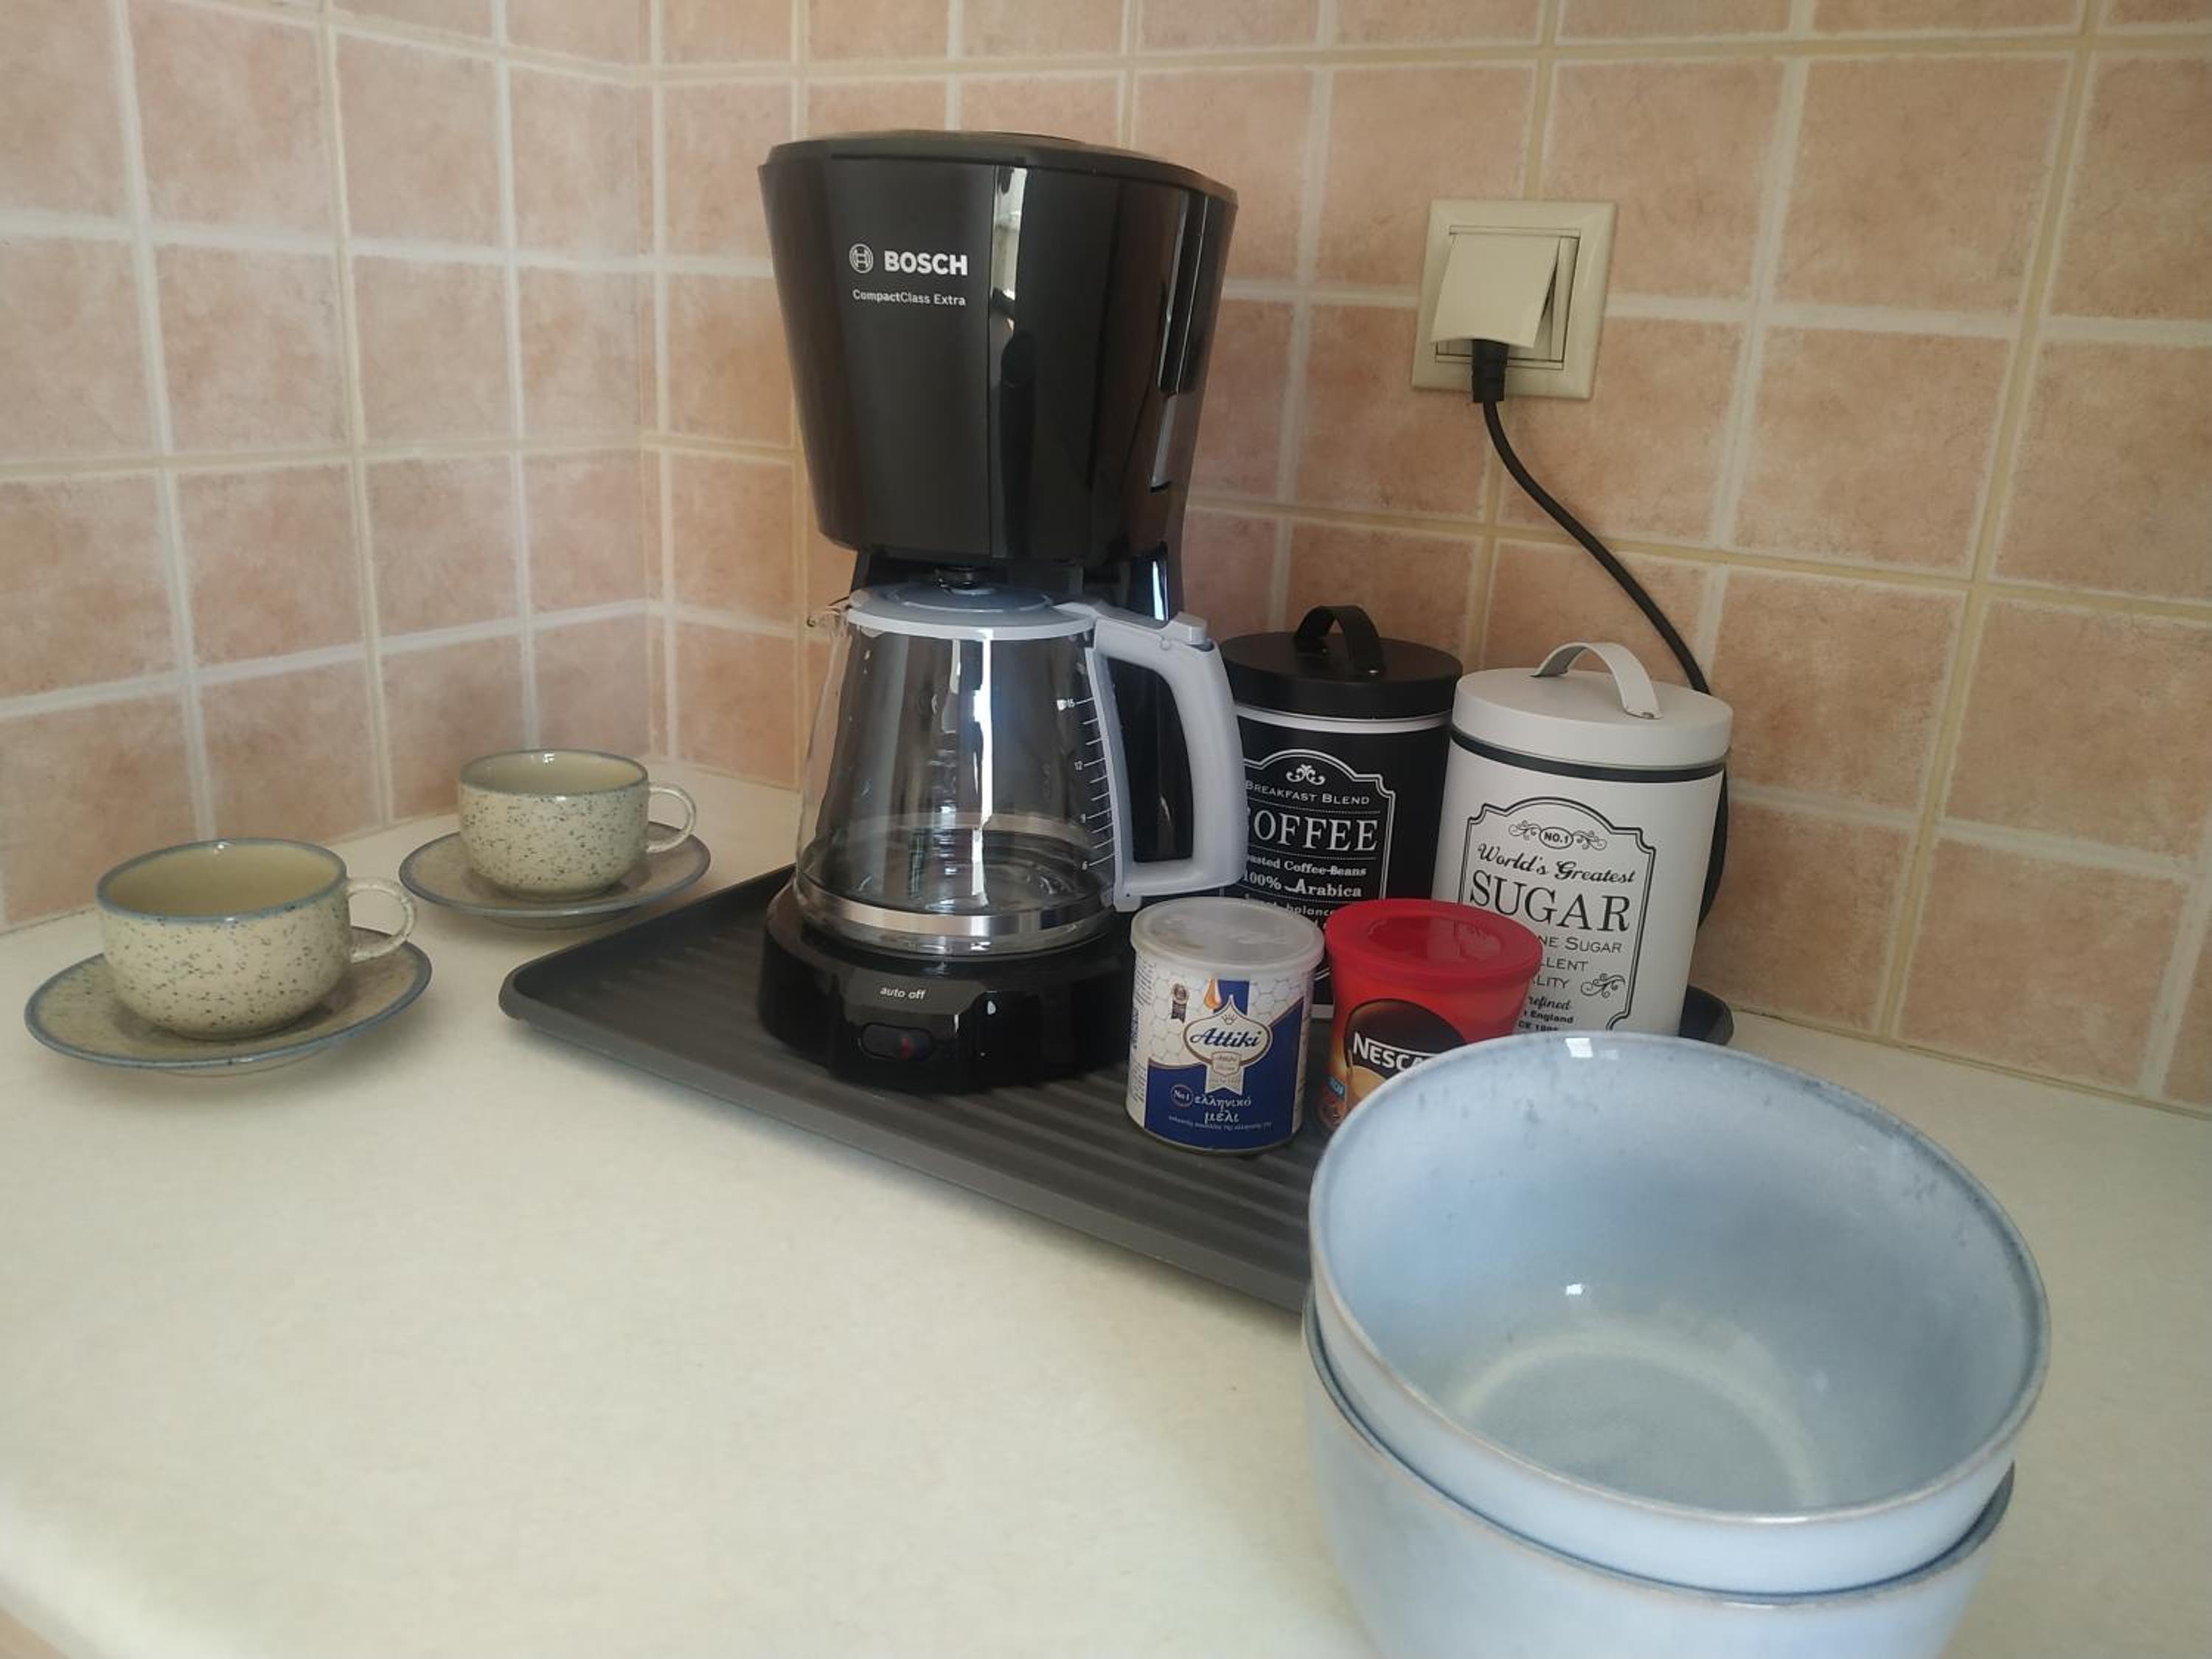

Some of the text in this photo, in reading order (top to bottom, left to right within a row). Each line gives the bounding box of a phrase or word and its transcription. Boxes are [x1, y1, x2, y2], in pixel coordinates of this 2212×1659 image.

[884, 250, 968, 276] BOSCH
[852, 288, 967, 306] CompactClass Extra
[1321, 793, 1371, 805] BLEND
[1248, 808, 1378, 852] OFFEE
[1477, 843, 1636, 883] World's Greatest
[1243, 872, 1363, 897] 100% Arabica
[1287, 902, 1333, 917] balanc
[1470, 869, 1630, 932] SUGAR
[1565, 936, 1622, 953] SUGAR
[880, 987, 926, 999] auto off
[1530, 1009, 1574, 1024] England
[1189, 1027, 1262, 1048] Attiki
[1353, 1032, 1429, 1071] NESCA
[1194, 1093, 1252, 1113] ελληνικό
[1204, 1109, 1240, 1124] μέλι
